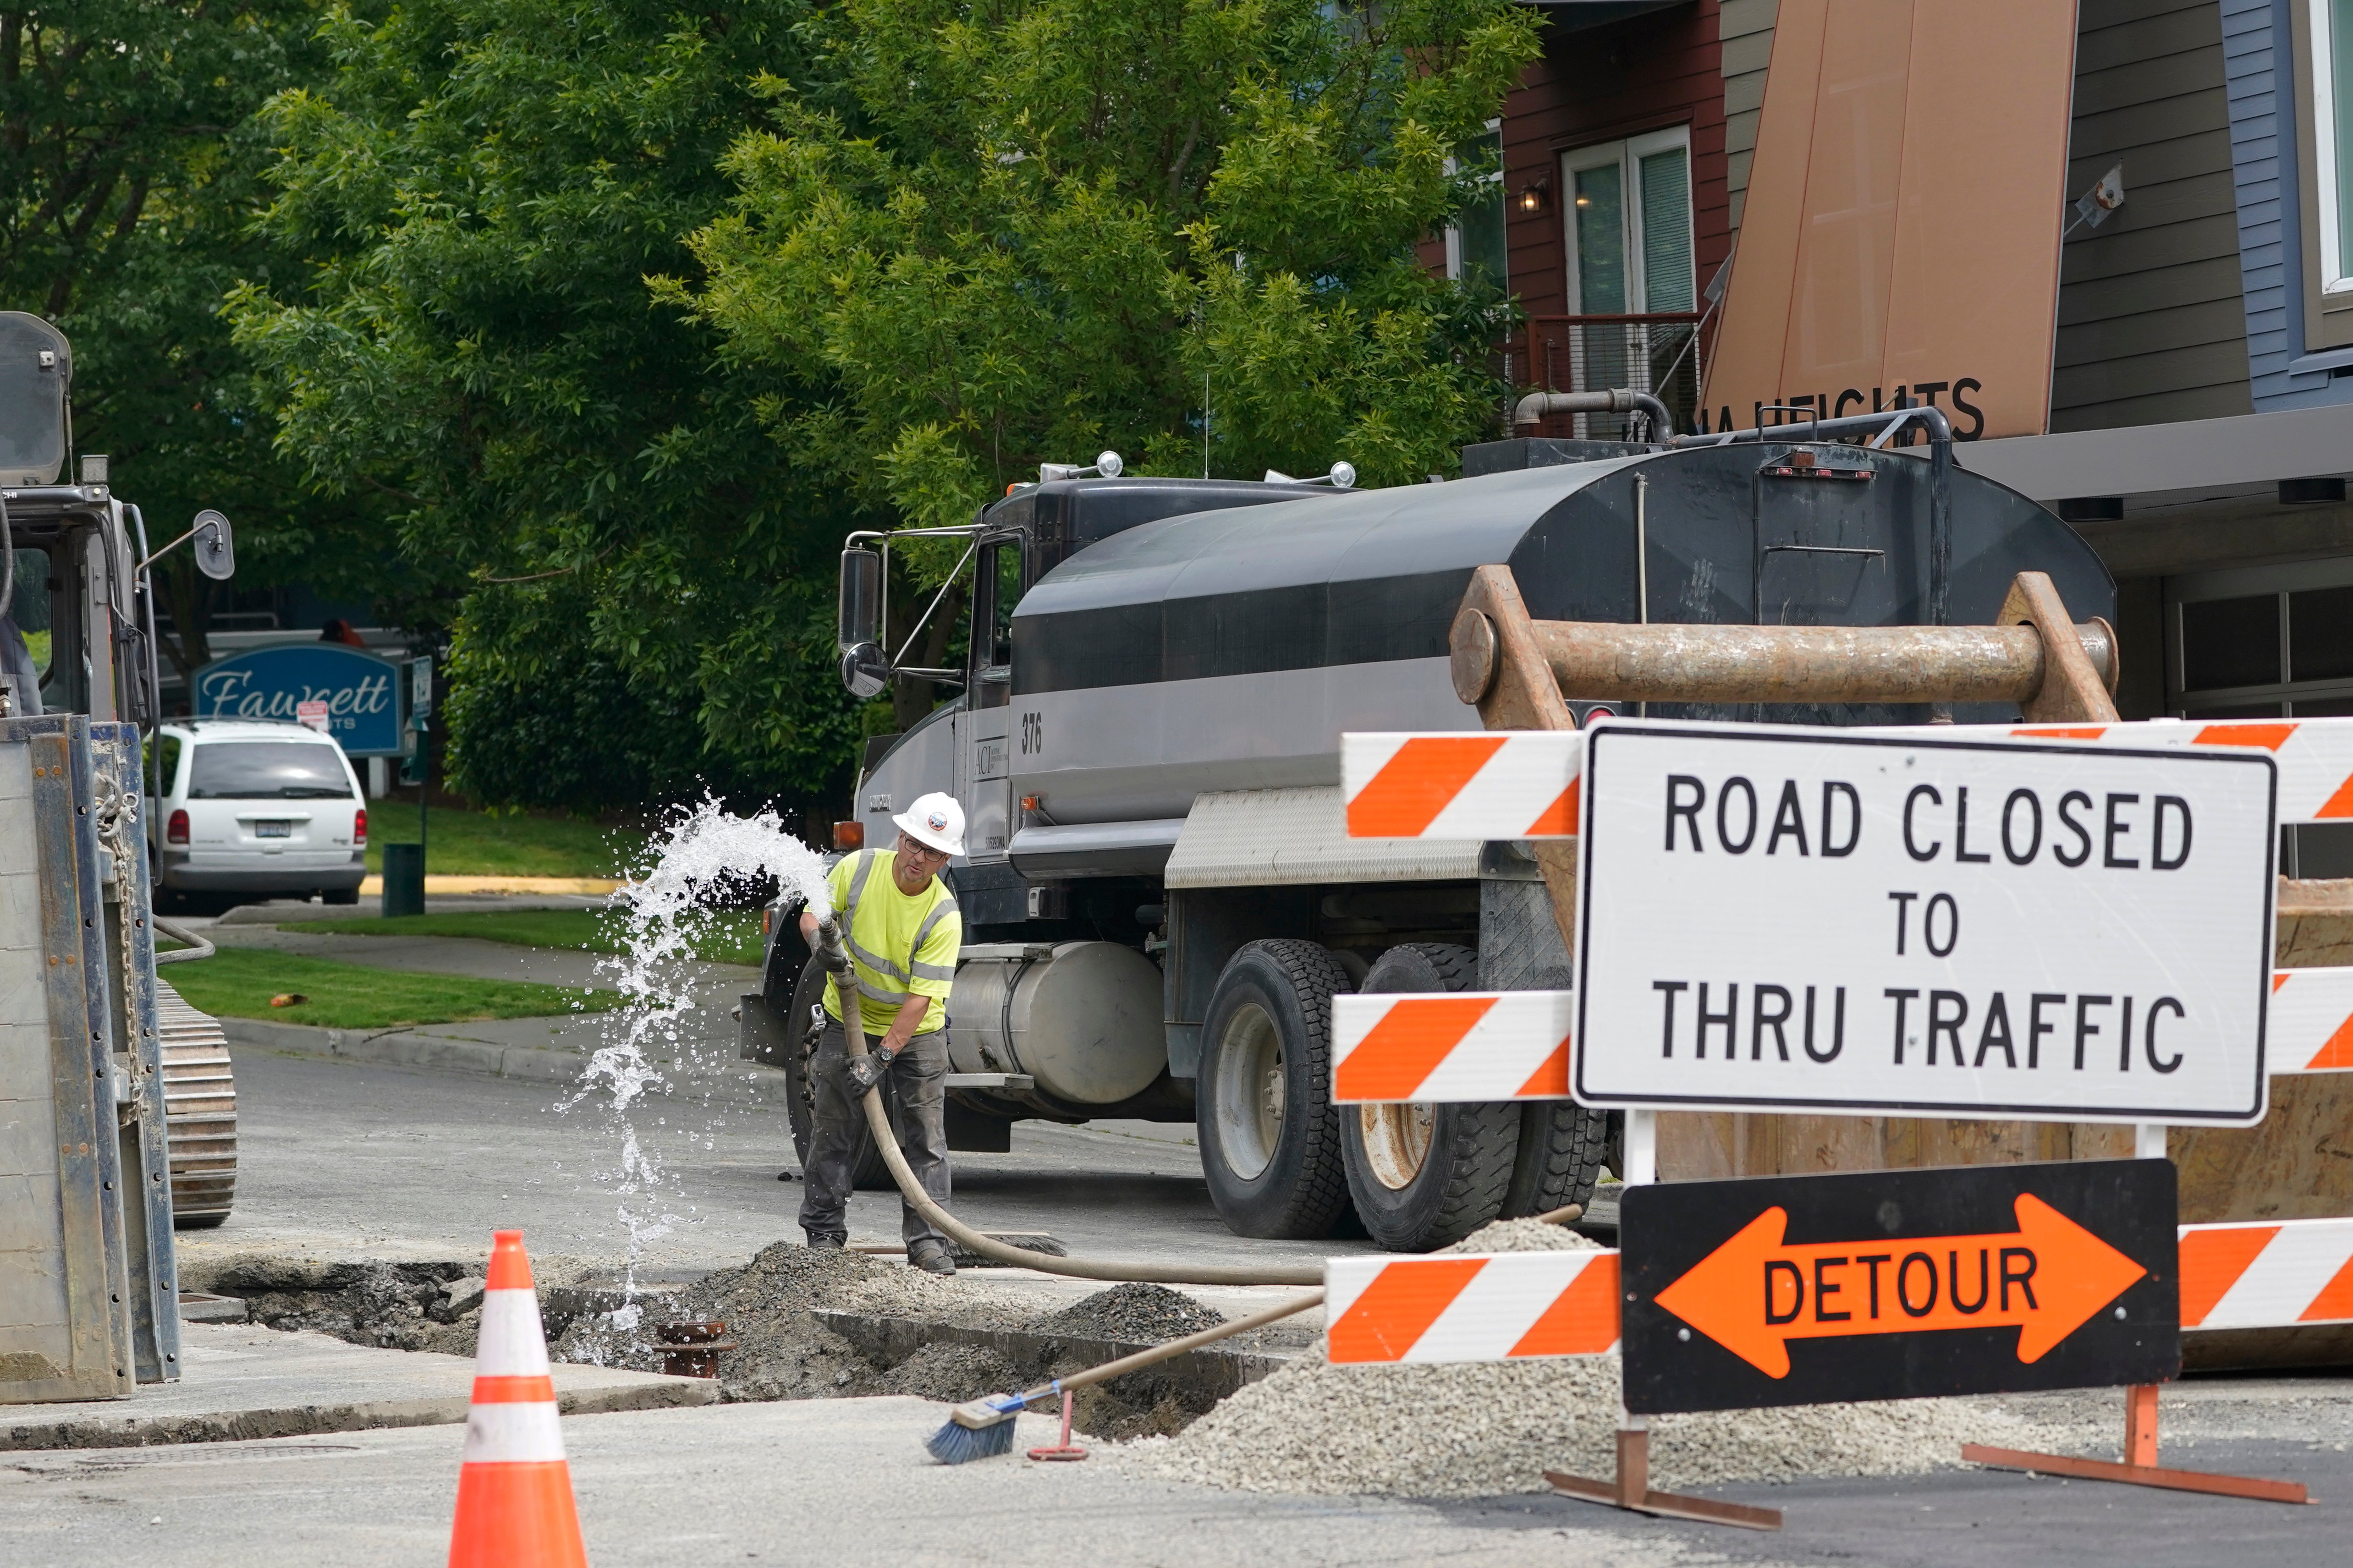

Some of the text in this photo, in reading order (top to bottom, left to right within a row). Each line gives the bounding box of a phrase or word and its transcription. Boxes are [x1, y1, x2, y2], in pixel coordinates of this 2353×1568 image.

[974, 746, 991, 775] ACI
[1023, 712, 1041, 755] 376
[1666, 775, 2192, 870] ROAD CLOSED
[1890, 893, 1957, 957] TO
[1654, 981, 2184, 1073] THRU TRAFFIC
[1764, 1247, 2039, 1325] DETOUR
